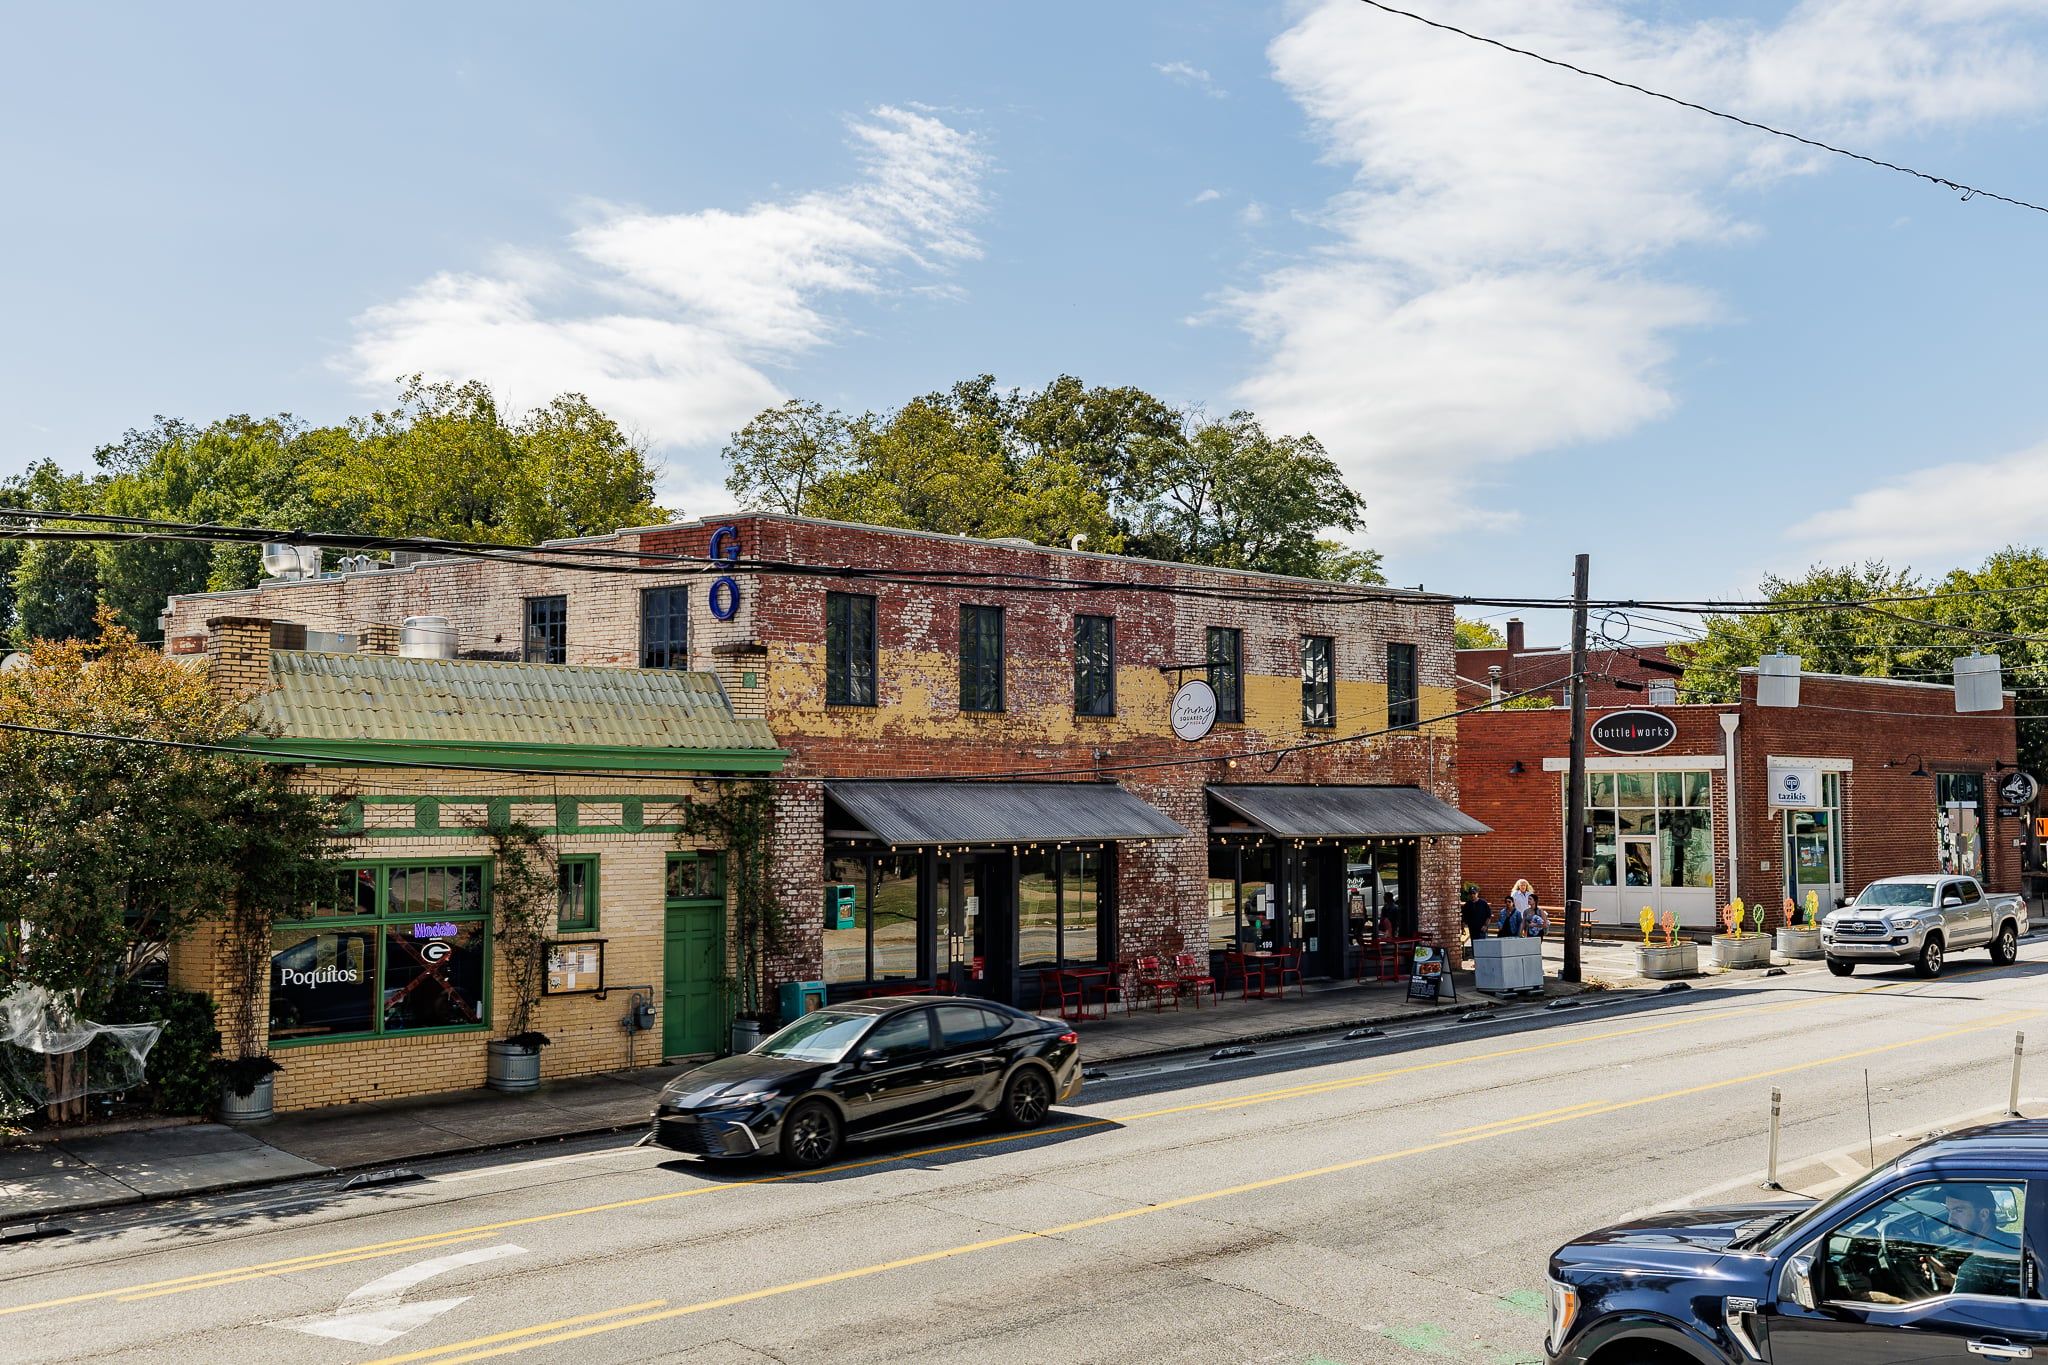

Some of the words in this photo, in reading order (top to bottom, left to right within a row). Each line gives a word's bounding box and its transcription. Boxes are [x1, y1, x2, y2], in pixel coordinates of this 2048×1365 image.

[709, 526, 741, 620] GO
[1173, 693, 1214, 729] Emmy
[1598, 727, 1630, 738] Bottle
[1637, 726, 1669, 737] works
[1778, 792, 1806, 800] tazikis
[414, 922, 457, 938] Modelo
[281, 964, 358, 989] Poquitos
